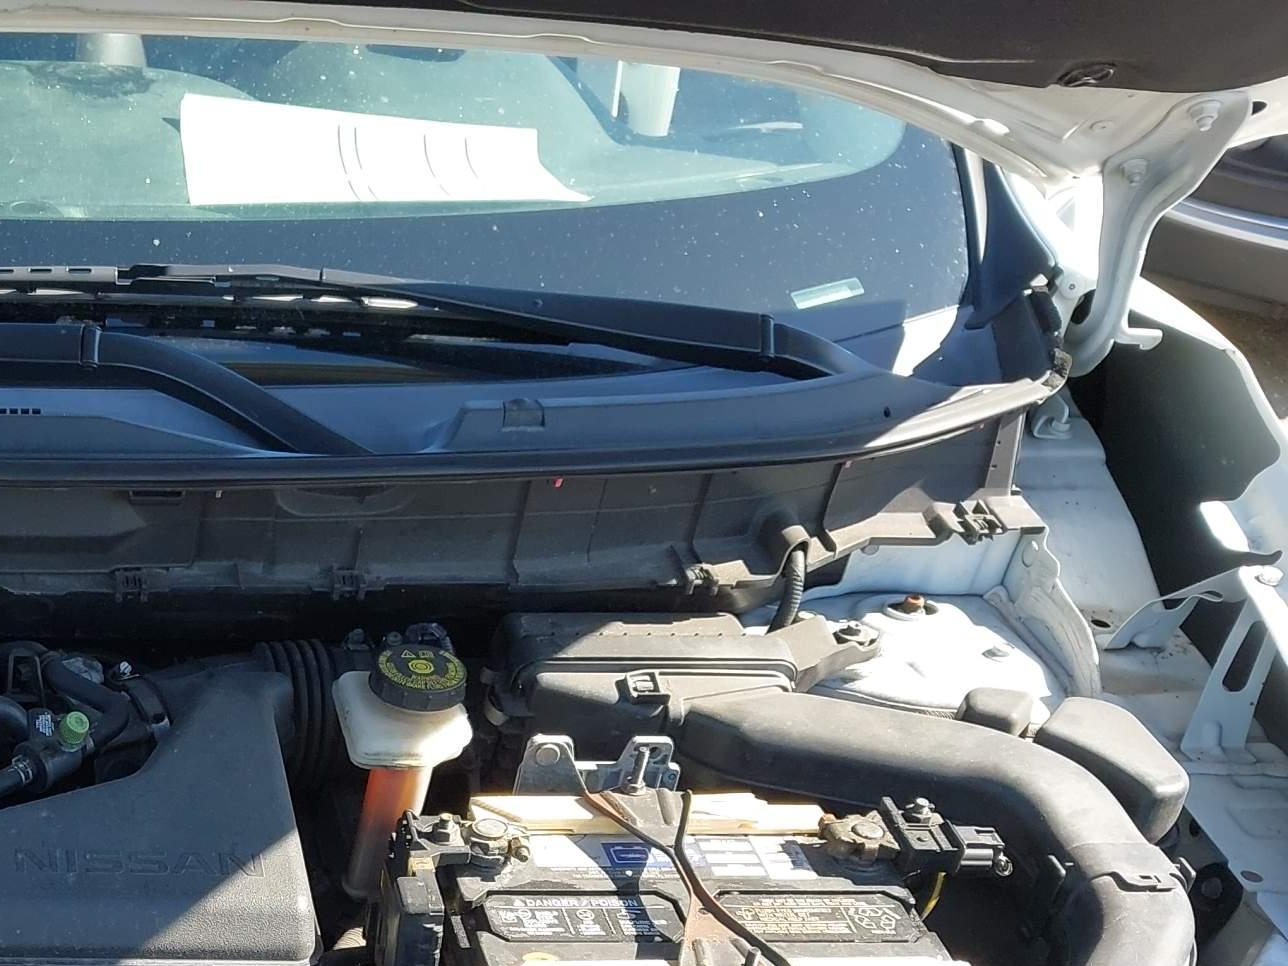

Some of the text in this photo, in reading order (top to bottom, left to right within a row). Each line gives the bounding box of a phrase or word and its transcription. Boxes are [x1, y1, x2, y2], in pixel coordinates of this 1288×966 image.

[15, 849, 265, 877] NISSAN
[526, 899, 579, 907] DANGER
[590, 899, 638, 907] POISON
